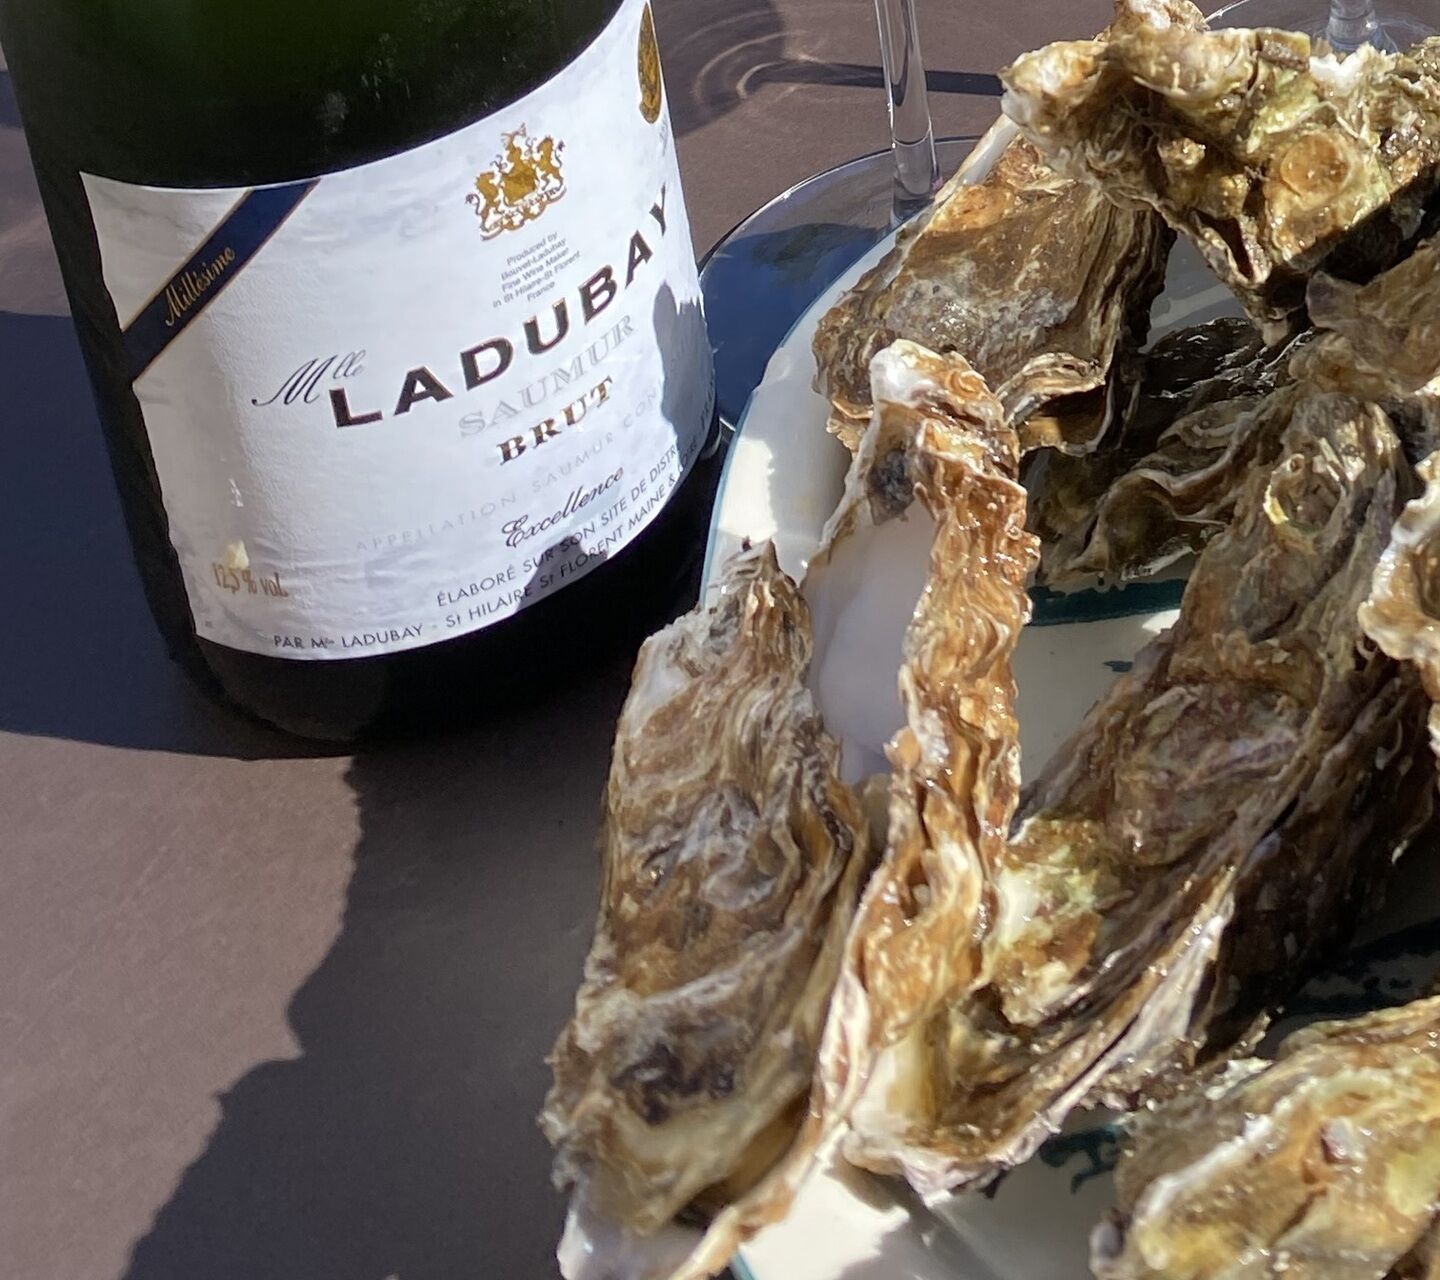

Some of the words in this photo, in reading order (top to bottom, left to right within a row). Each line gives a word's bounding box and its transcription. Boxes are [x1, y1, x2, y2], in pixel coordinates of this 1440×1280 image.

[328, 181, 667, 428] LADUBAY
[459, 313, 635, 437] SAUMUR
[496, 376, 614, 466] BRUT
[273, 635, 305, 649] PAR
[342, 623, 423, 648] LADUBAY
[469, 587, 533, 620] HILAIRE
[628, 484, 666, 531] MAINE
[436, 564, 517, 607] ÉLABORÉ
[523, 548, 554, 573] SUR
[559, 521, 595, 553] SON
[601, 497, 628, 527] SITE
[631, 479, 648, 501] DE
[501, 467, 624, 548] Excellence
